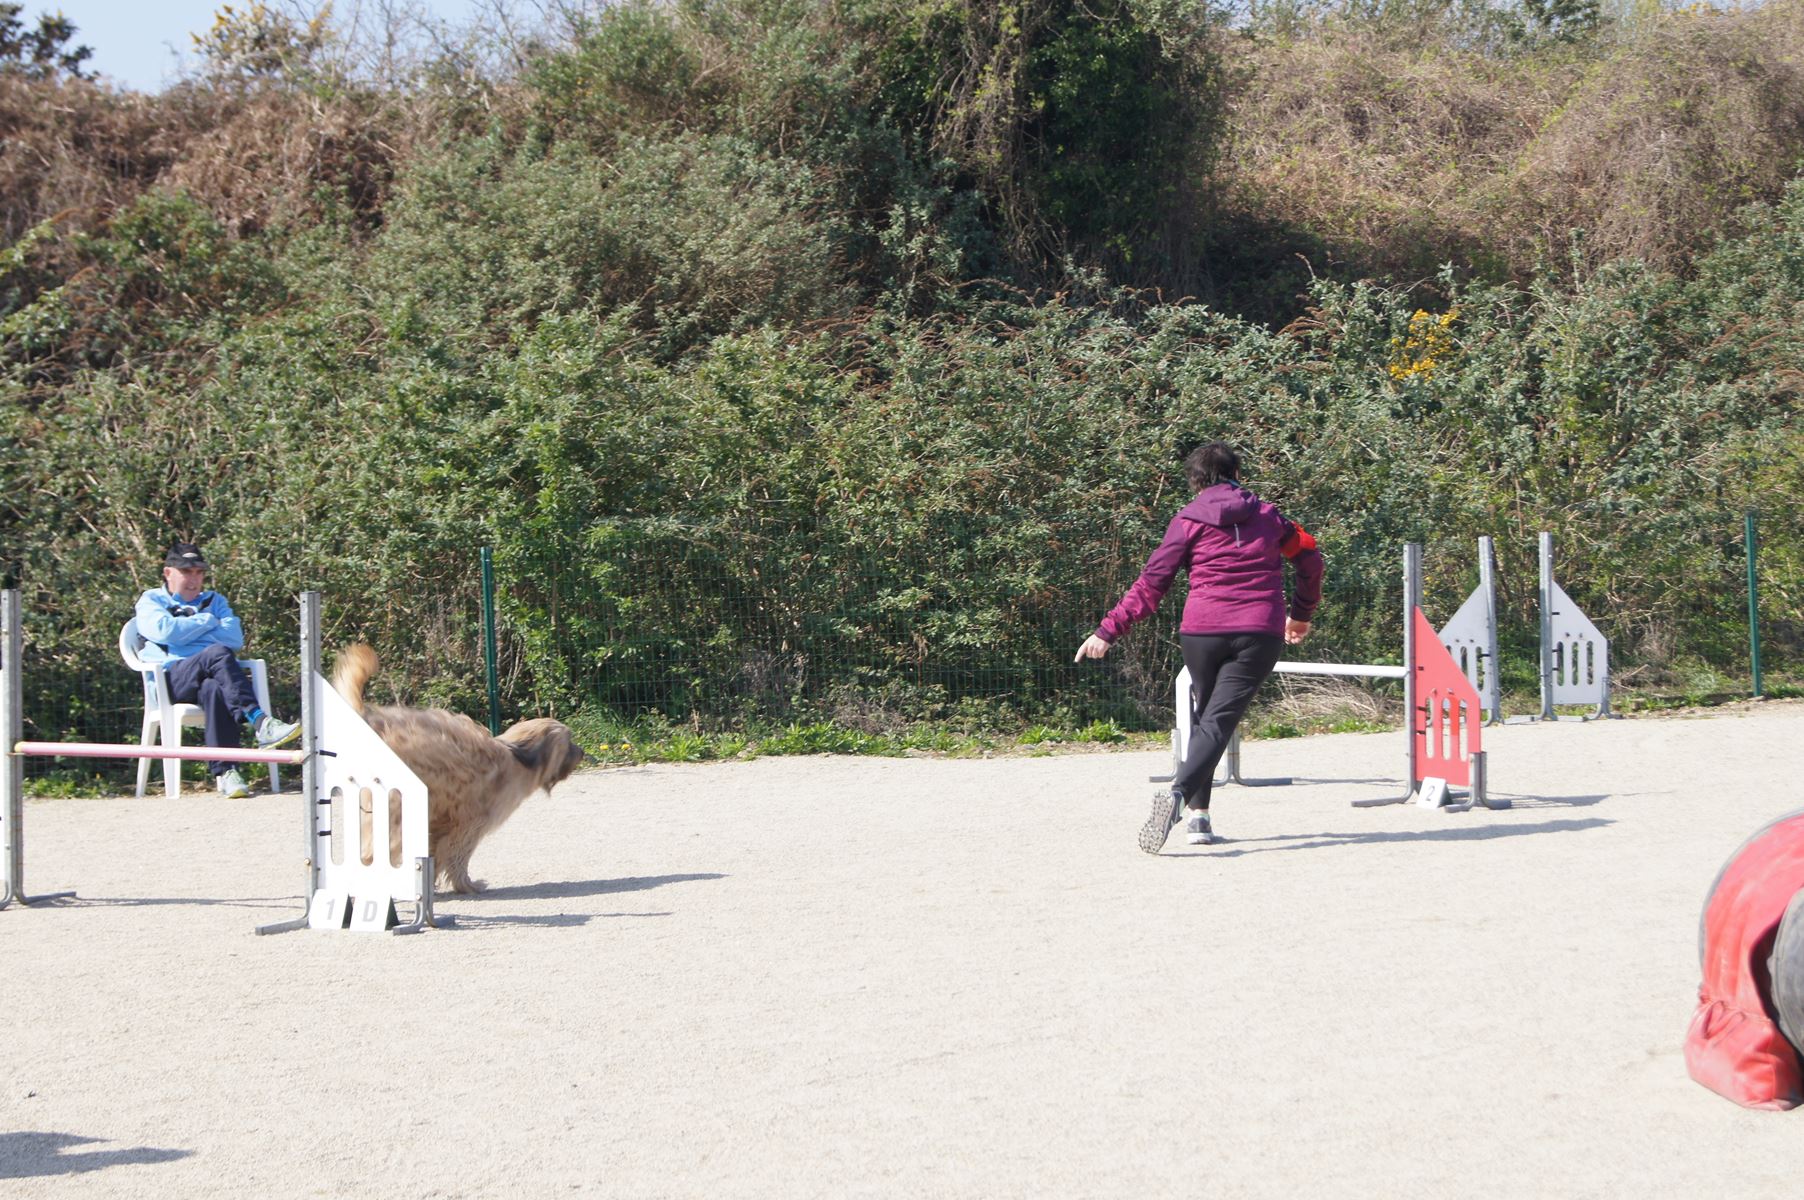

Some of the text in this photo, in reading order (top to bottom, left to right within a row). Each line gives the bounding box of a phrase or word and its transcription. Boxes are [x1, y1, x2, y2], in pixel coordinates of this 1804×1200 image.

[1425, 785, 1436, 802] 2
[325, 898, 336, 921] 1
[362, 900, 378, 923] D
